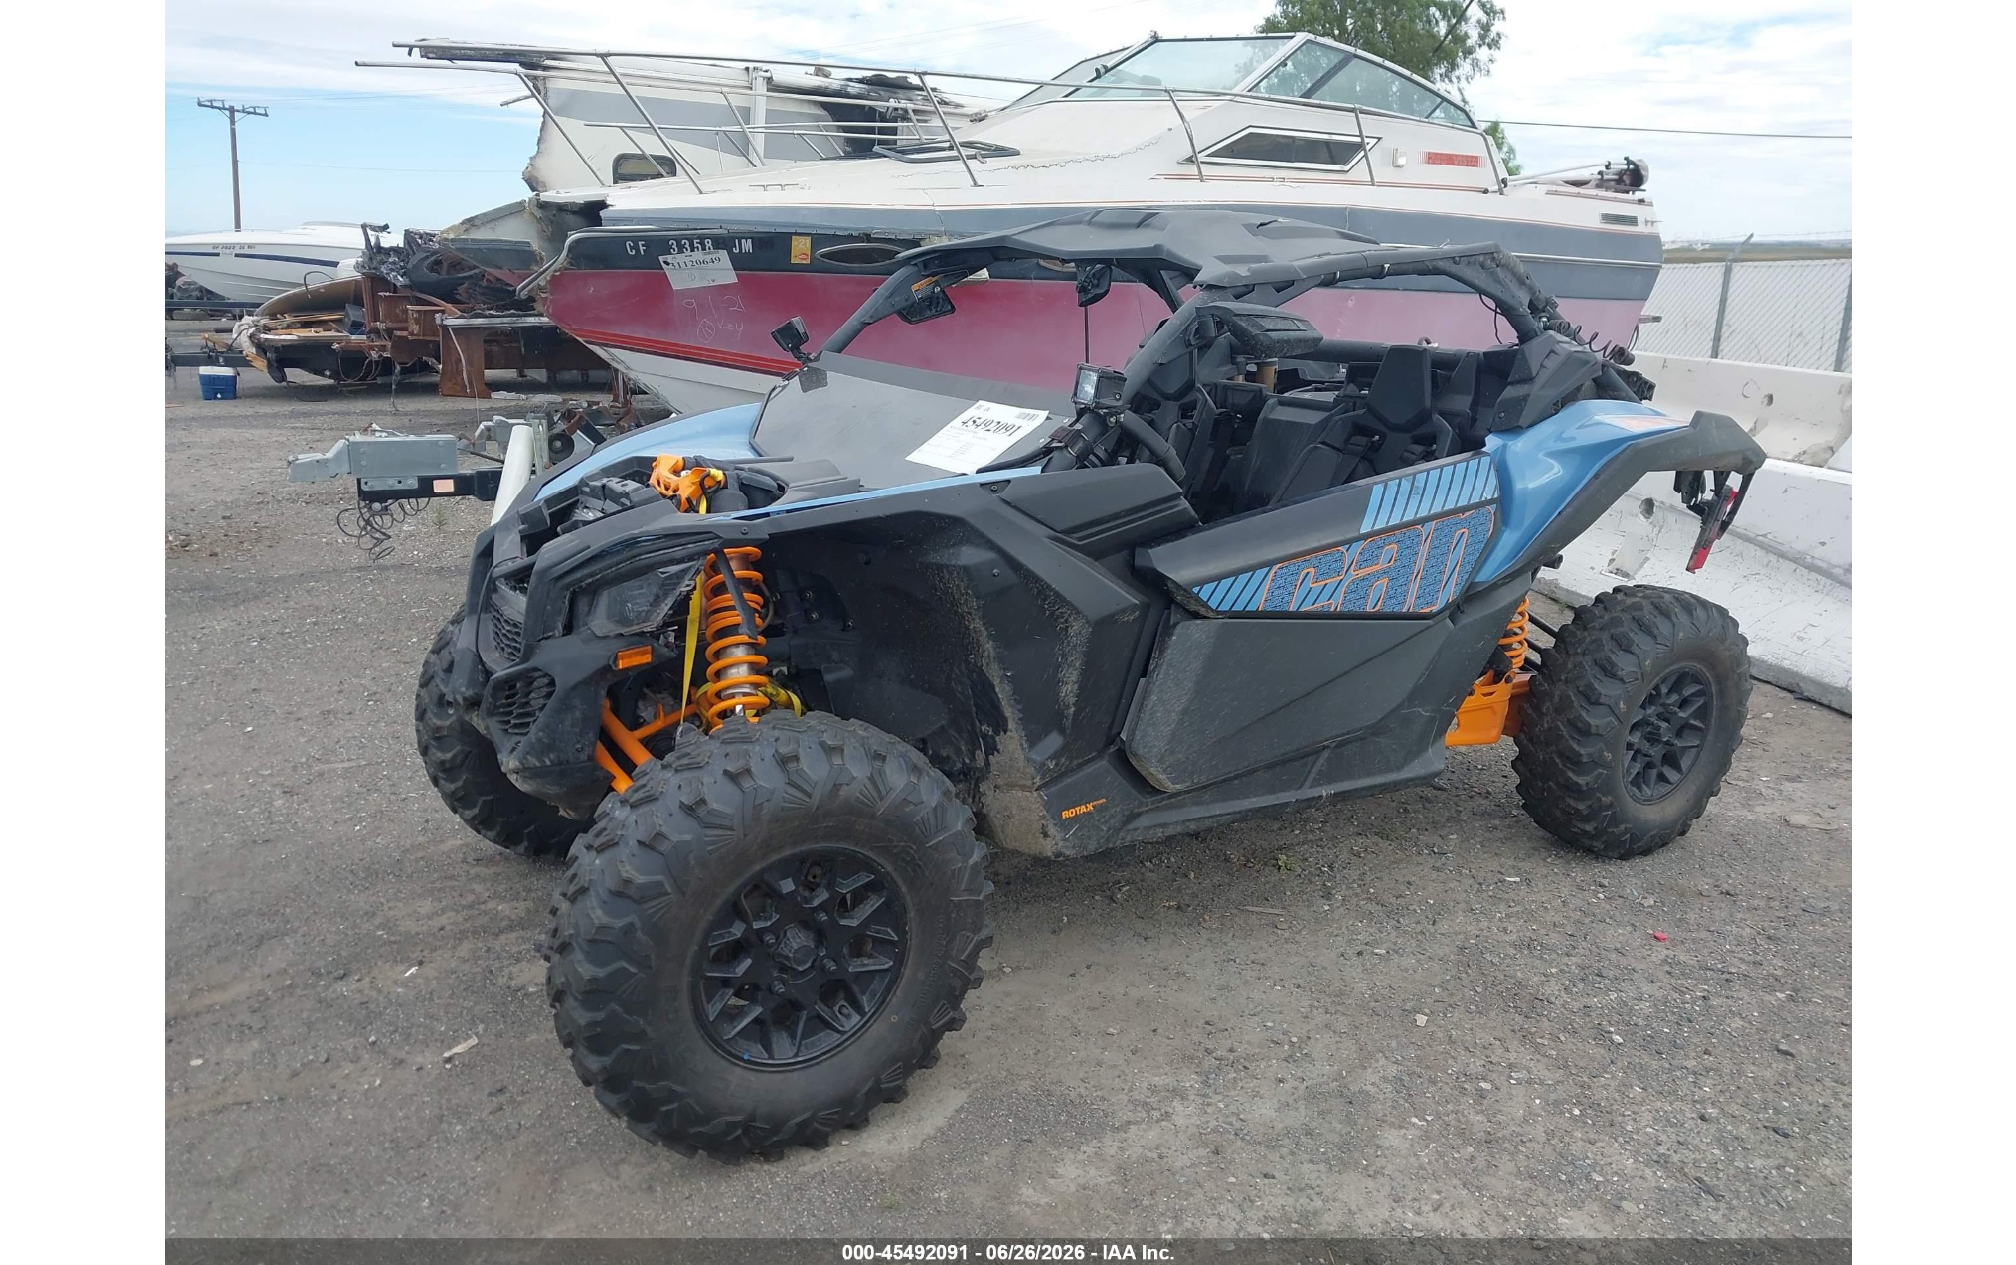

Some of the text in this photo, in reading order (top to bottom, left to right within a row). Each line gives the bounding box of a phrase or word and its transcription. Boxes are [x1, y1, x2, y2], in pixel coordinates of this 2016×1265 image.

[1453, 155, 1477, 166] VISTA
[625, 238, 753, 255] CF 3358 JM
[669, 256, 721, 268] 31120649
[961, 416, 1023, 437] 45492091
[1061, 802, 1094, 820] ROTAX
